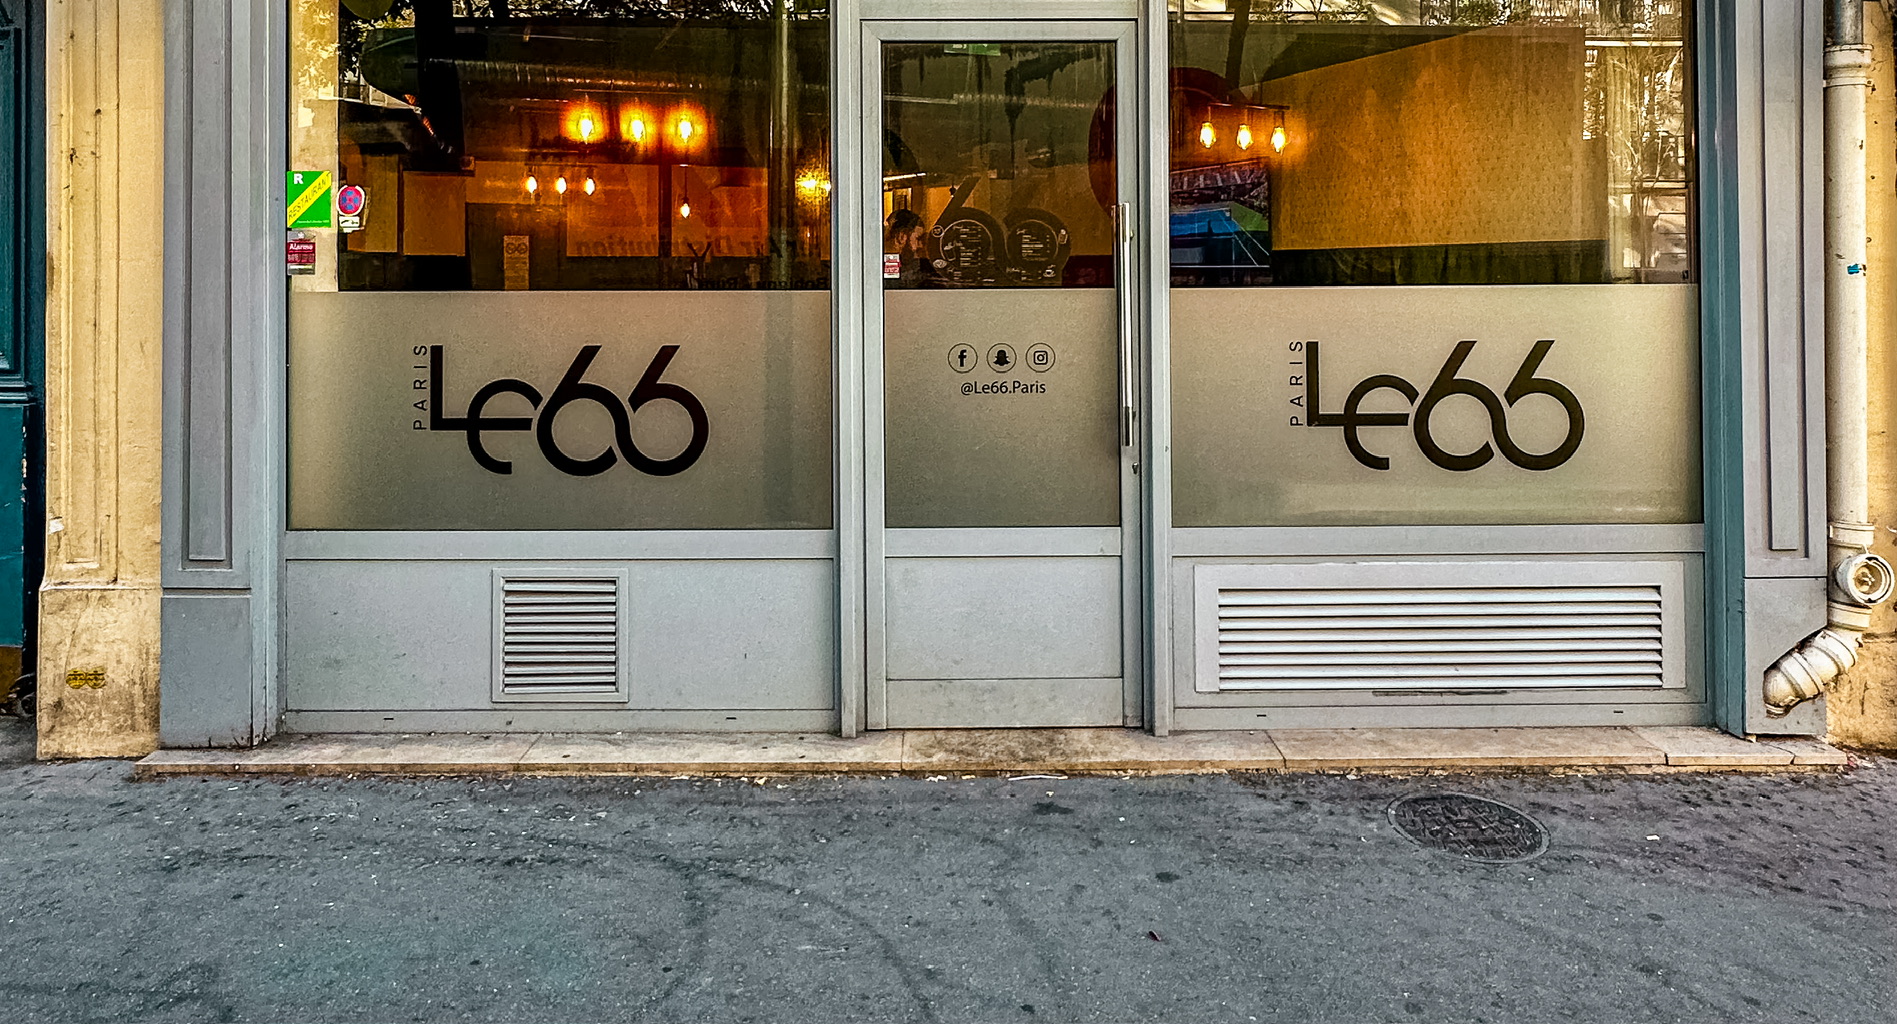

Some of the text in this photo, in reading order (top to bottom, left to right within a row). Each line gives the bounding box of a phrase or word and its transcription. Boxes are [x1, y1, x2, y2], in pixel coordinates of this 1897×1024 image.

[293, 173, 304, 184] R
[413, 344, 427, 431] PARIS
[430, 345, 710, 476] Le66
[961, 380, 1046, 396] @Le66.Paris
[1289, 340, 1304, 427] PARIS
[1305, 340, 1585, 471] Le66
